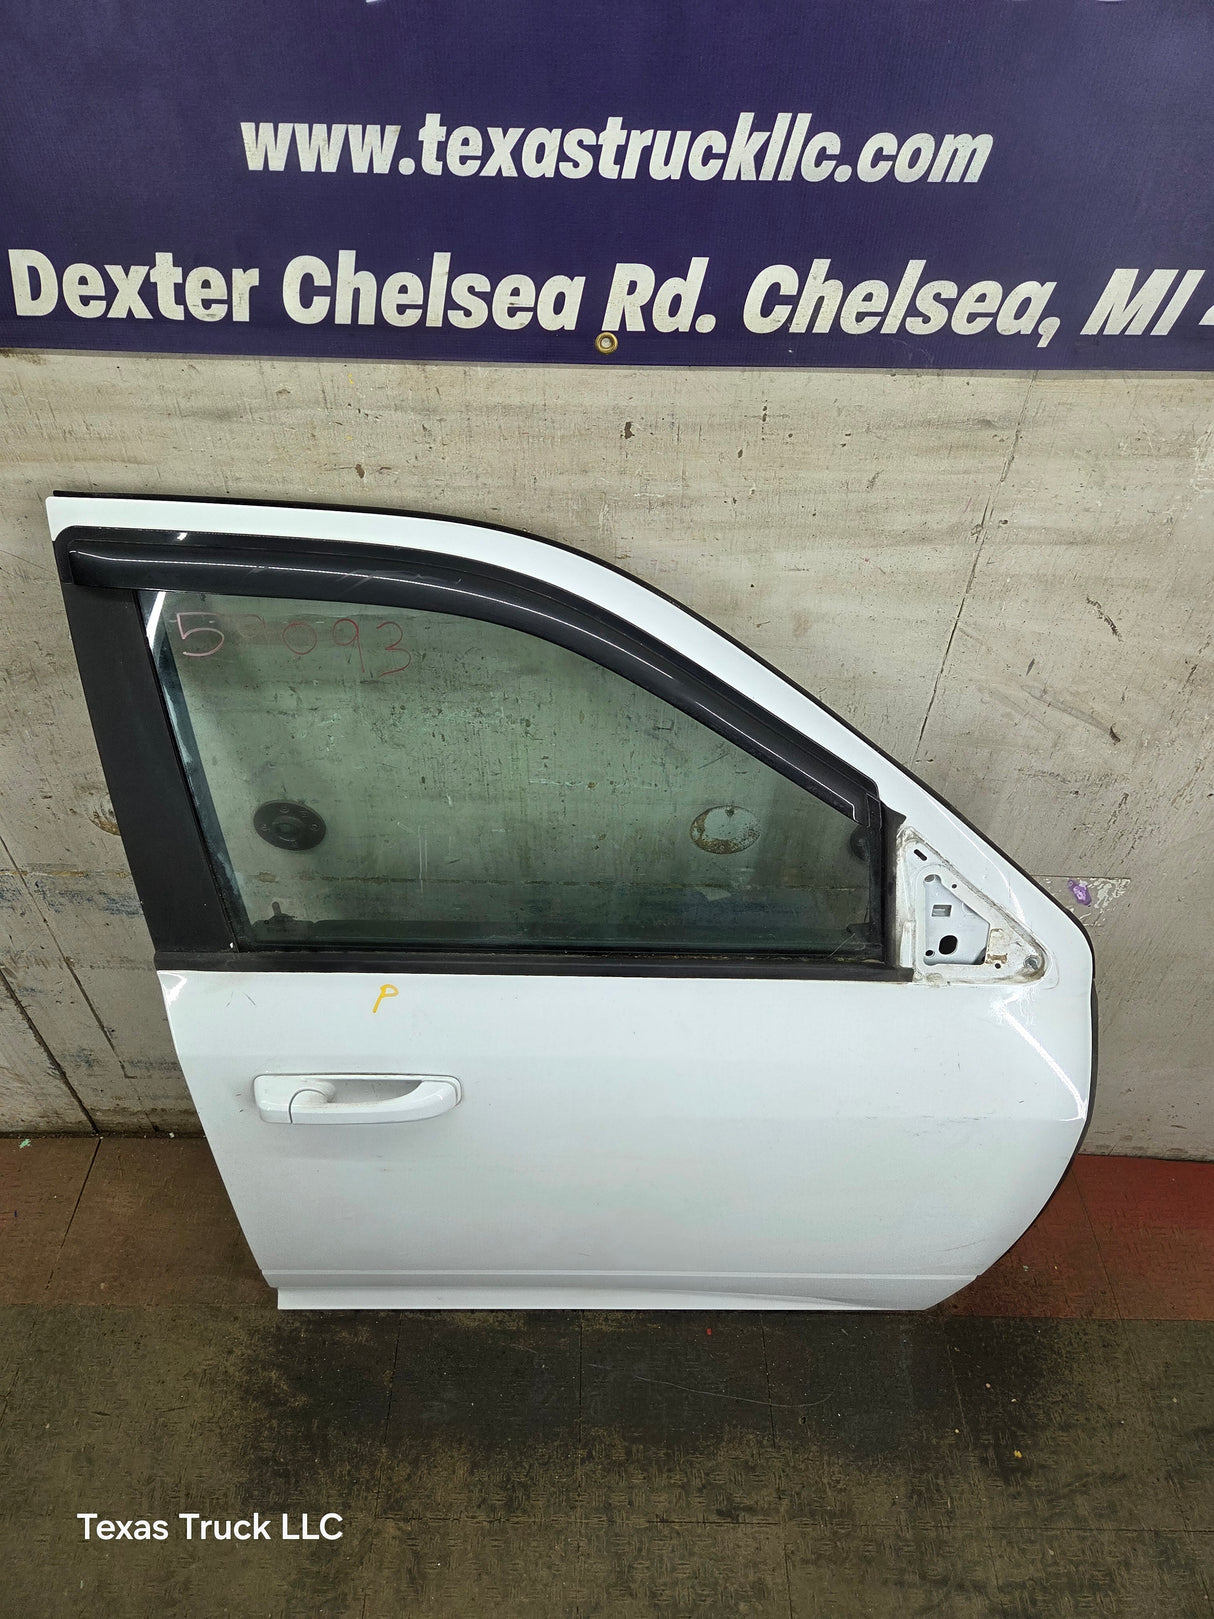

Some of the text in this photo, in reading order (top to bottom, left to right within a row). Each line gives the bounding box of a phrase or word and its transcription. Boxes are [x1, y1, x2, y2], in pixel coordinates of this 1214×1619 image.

[240, 112, 994, 183] www.texastruckllc.com
[8, 249, 1206, 347] Dexter Chelsea Rd. Chelsea, MI
[372, 984, 399, 1013] P
